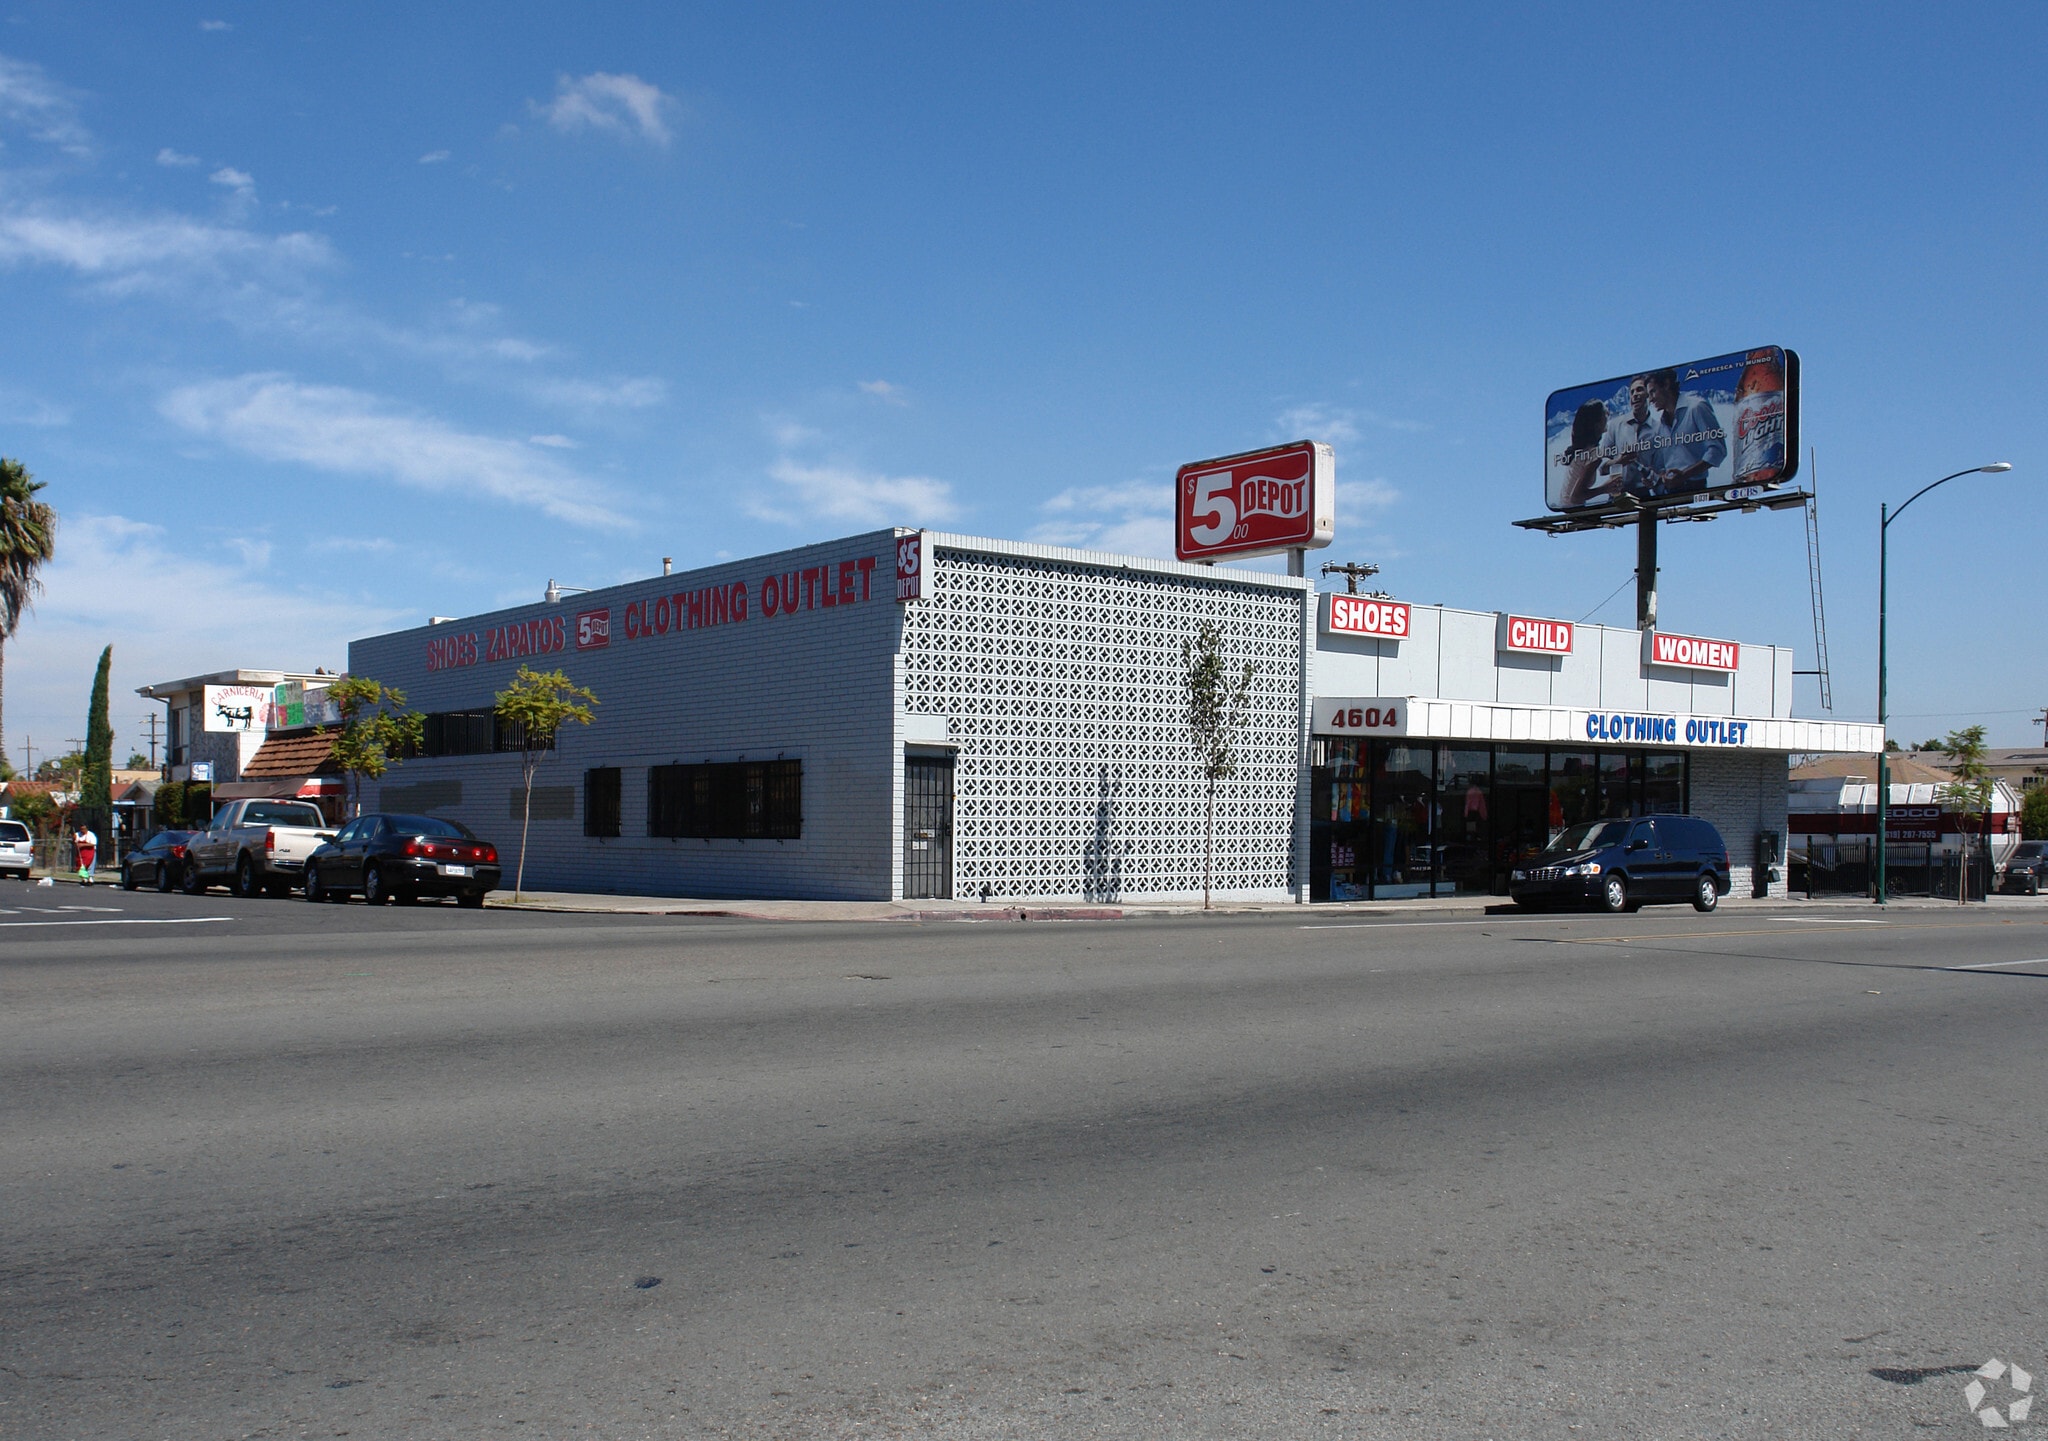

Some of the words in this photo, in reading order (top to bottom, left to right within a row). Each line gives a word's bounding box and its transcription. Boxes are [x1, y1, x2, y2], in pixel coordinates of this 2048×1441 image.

[1699, 364, 1733, 375] REFRESCA
[1746, 356, 1772, 366] MUNDO
[1554, 451, 1572, 467] Por
[1596, 443, 1618, 459] Una
[1620, 439, 1651, 455] Junta
[1653, 434, 1673, 449] Sin
[1675, 426, 1727, 446] Horarios.
[1243, 479, 1306, 515] DEPOT
[1739, 487, 1759, 498] CBS
[897, 538, 919, 575] $5
[624, 581, 749, 640] CLOTHING
[761, 556, 877, 617] OUTLET
[897, 575, 920, 599] DEPOT
[1333, 599, 1408, 635] SHOES
[427, 633, 479, 672] SHOES
[485, 616, 566, 662] ZAPATOS
[1511, 620, 1570, 651] CHILD
[1657, 637, 1735, 668] WOMEN
[210, 685, 265, 706] CARNICERIA
[1331, 707, 1398, 729] 4604
[1586, 713, 1677, 742] CLOTHING
[1685, 718, 1749, 745] OUTLET
